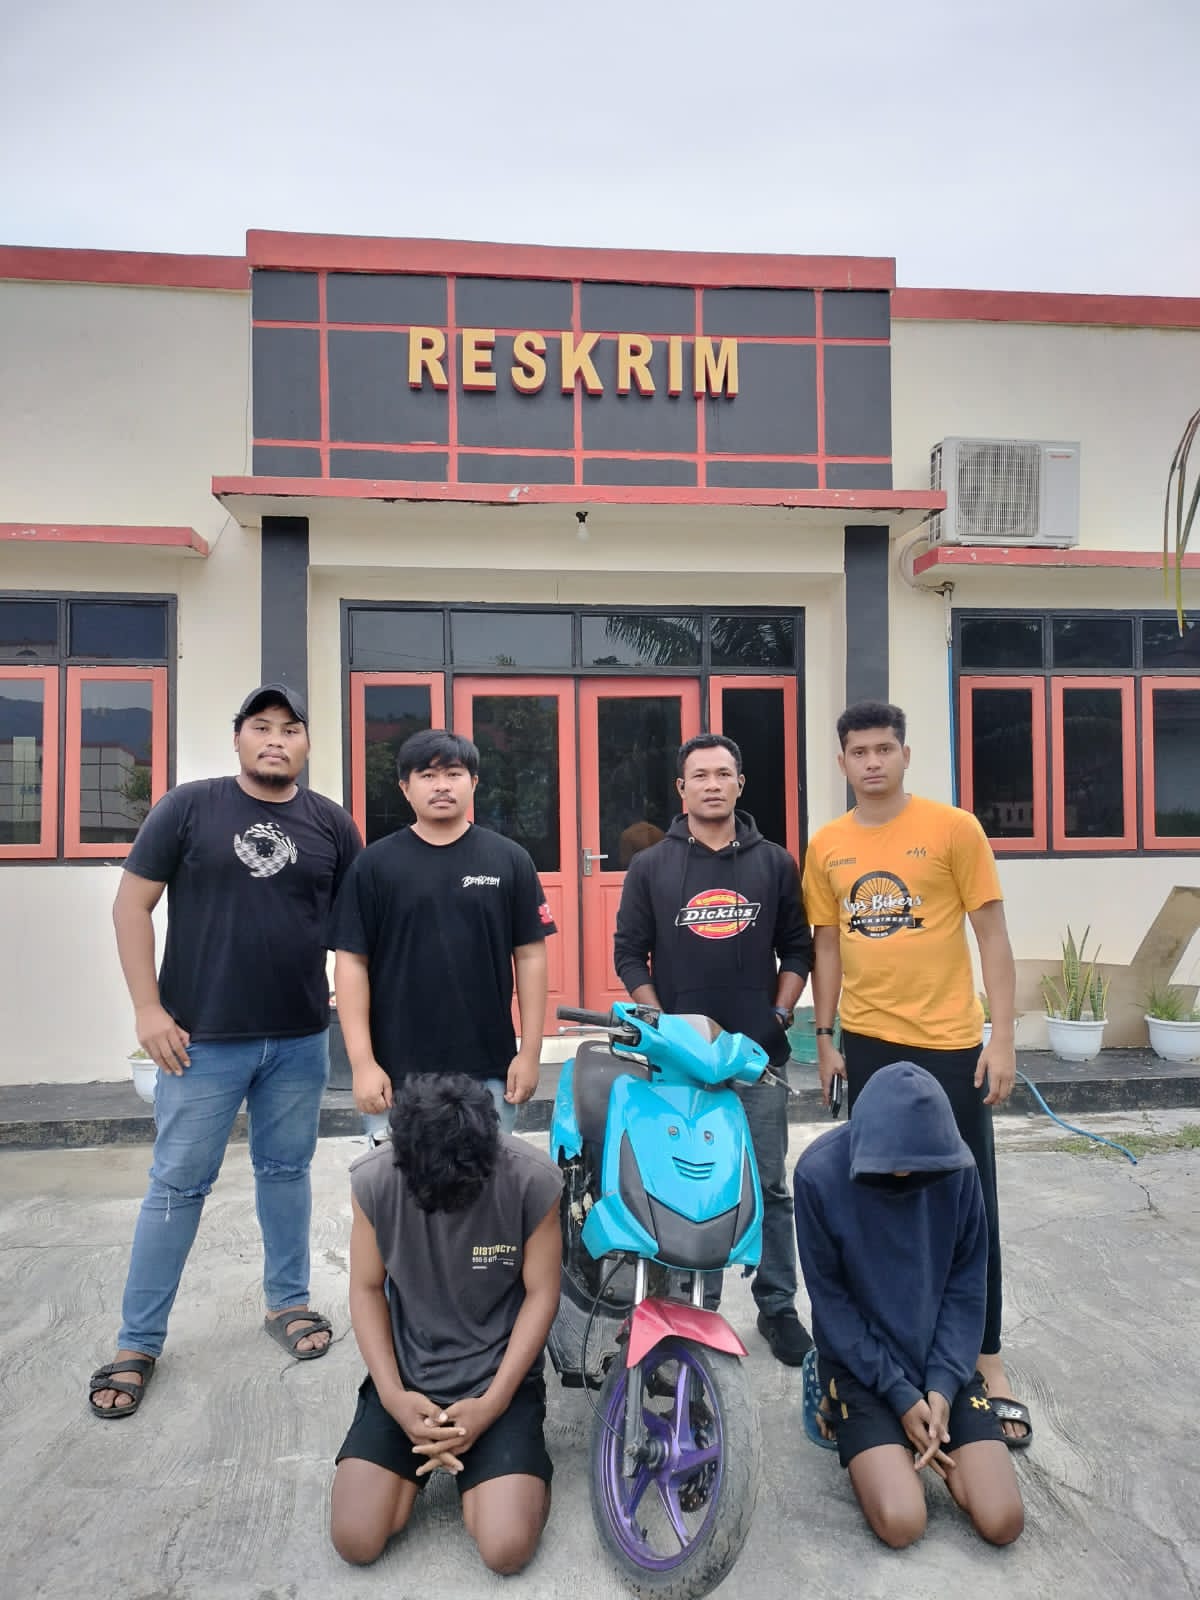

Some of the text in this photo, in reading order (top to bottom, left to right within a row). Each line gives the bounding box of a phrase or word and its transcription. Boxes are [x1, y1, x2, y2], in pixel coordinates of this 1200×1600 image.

[408, 326, 740, 398] RESKRIM
[871, 894, 922, 910] Bikers
[683, 907, 753, 921] Dickies
